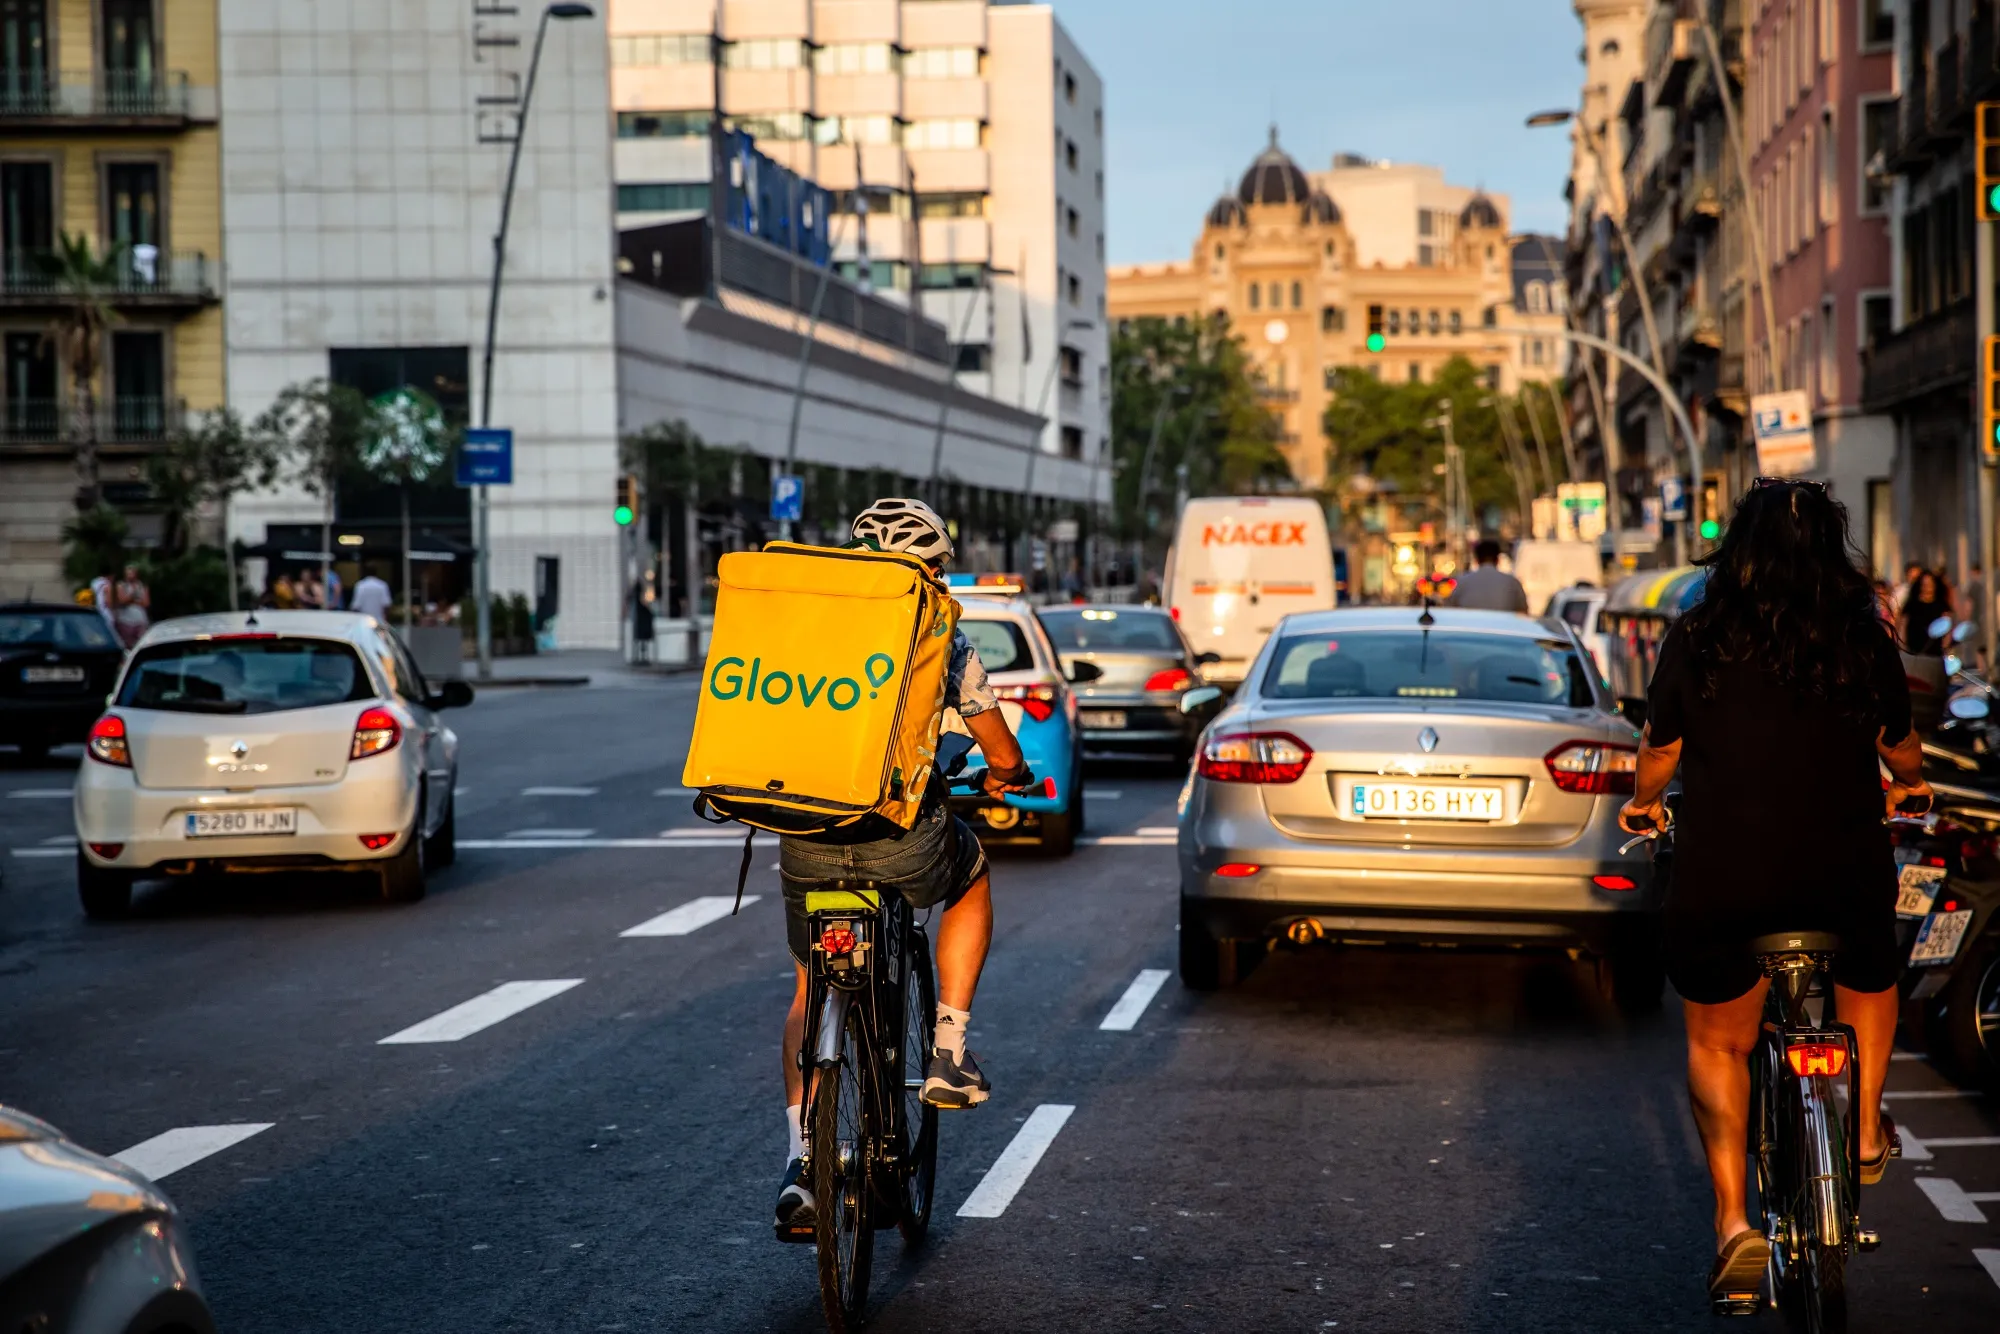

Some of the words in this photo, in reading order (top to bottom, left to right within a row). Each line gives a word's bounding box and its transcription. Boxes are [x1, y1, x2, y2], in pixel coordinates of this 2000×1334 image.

[776, 479, 797, 504] P
[1202, 520, 1307, 547] NACEX
[710, 656, 861, 711] Glovo
[1370, 788, 1436, 812] 0136
[1446, 791, 1494, 813] HYY
[199, 813, 247, 831] 5280
[253, 812, 291, 830] HJN
